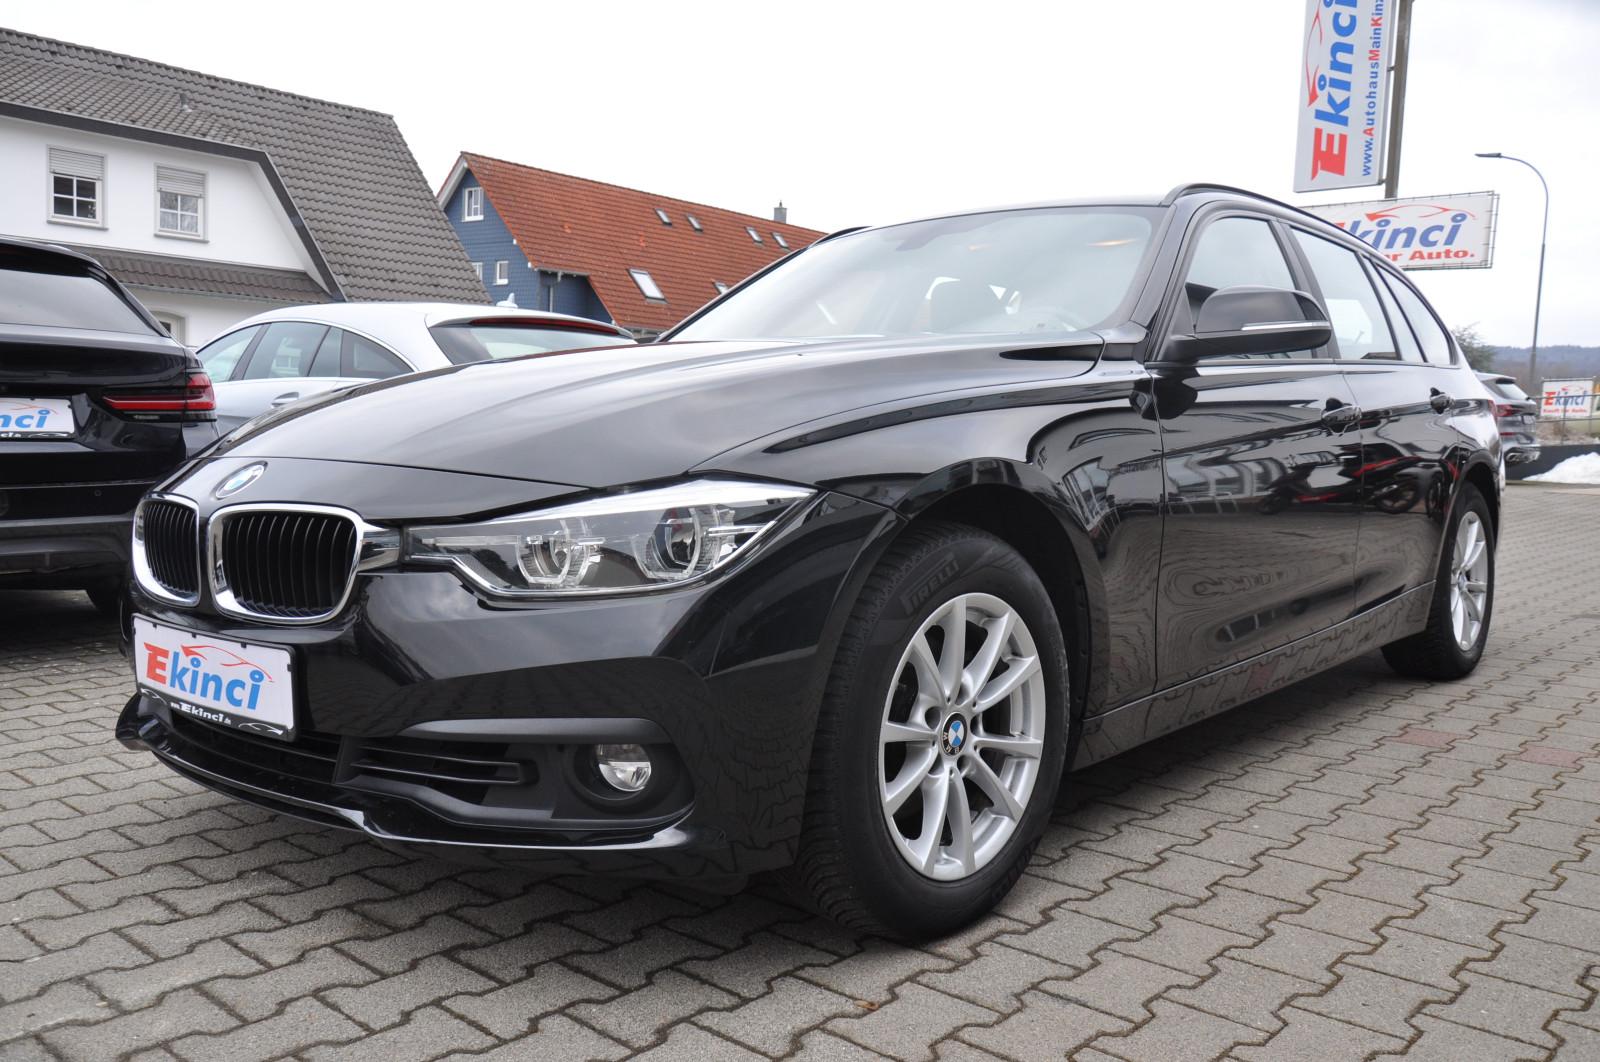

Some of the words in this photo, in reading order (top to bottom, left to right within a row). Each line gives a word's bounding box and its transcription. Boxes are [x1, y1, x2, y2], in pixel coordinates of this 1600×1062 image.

[1408, 248, 1475, 261] Auto.
[144, 642, 265, 711] Ekinci
[179, 701, 224, 722] Ekinci
